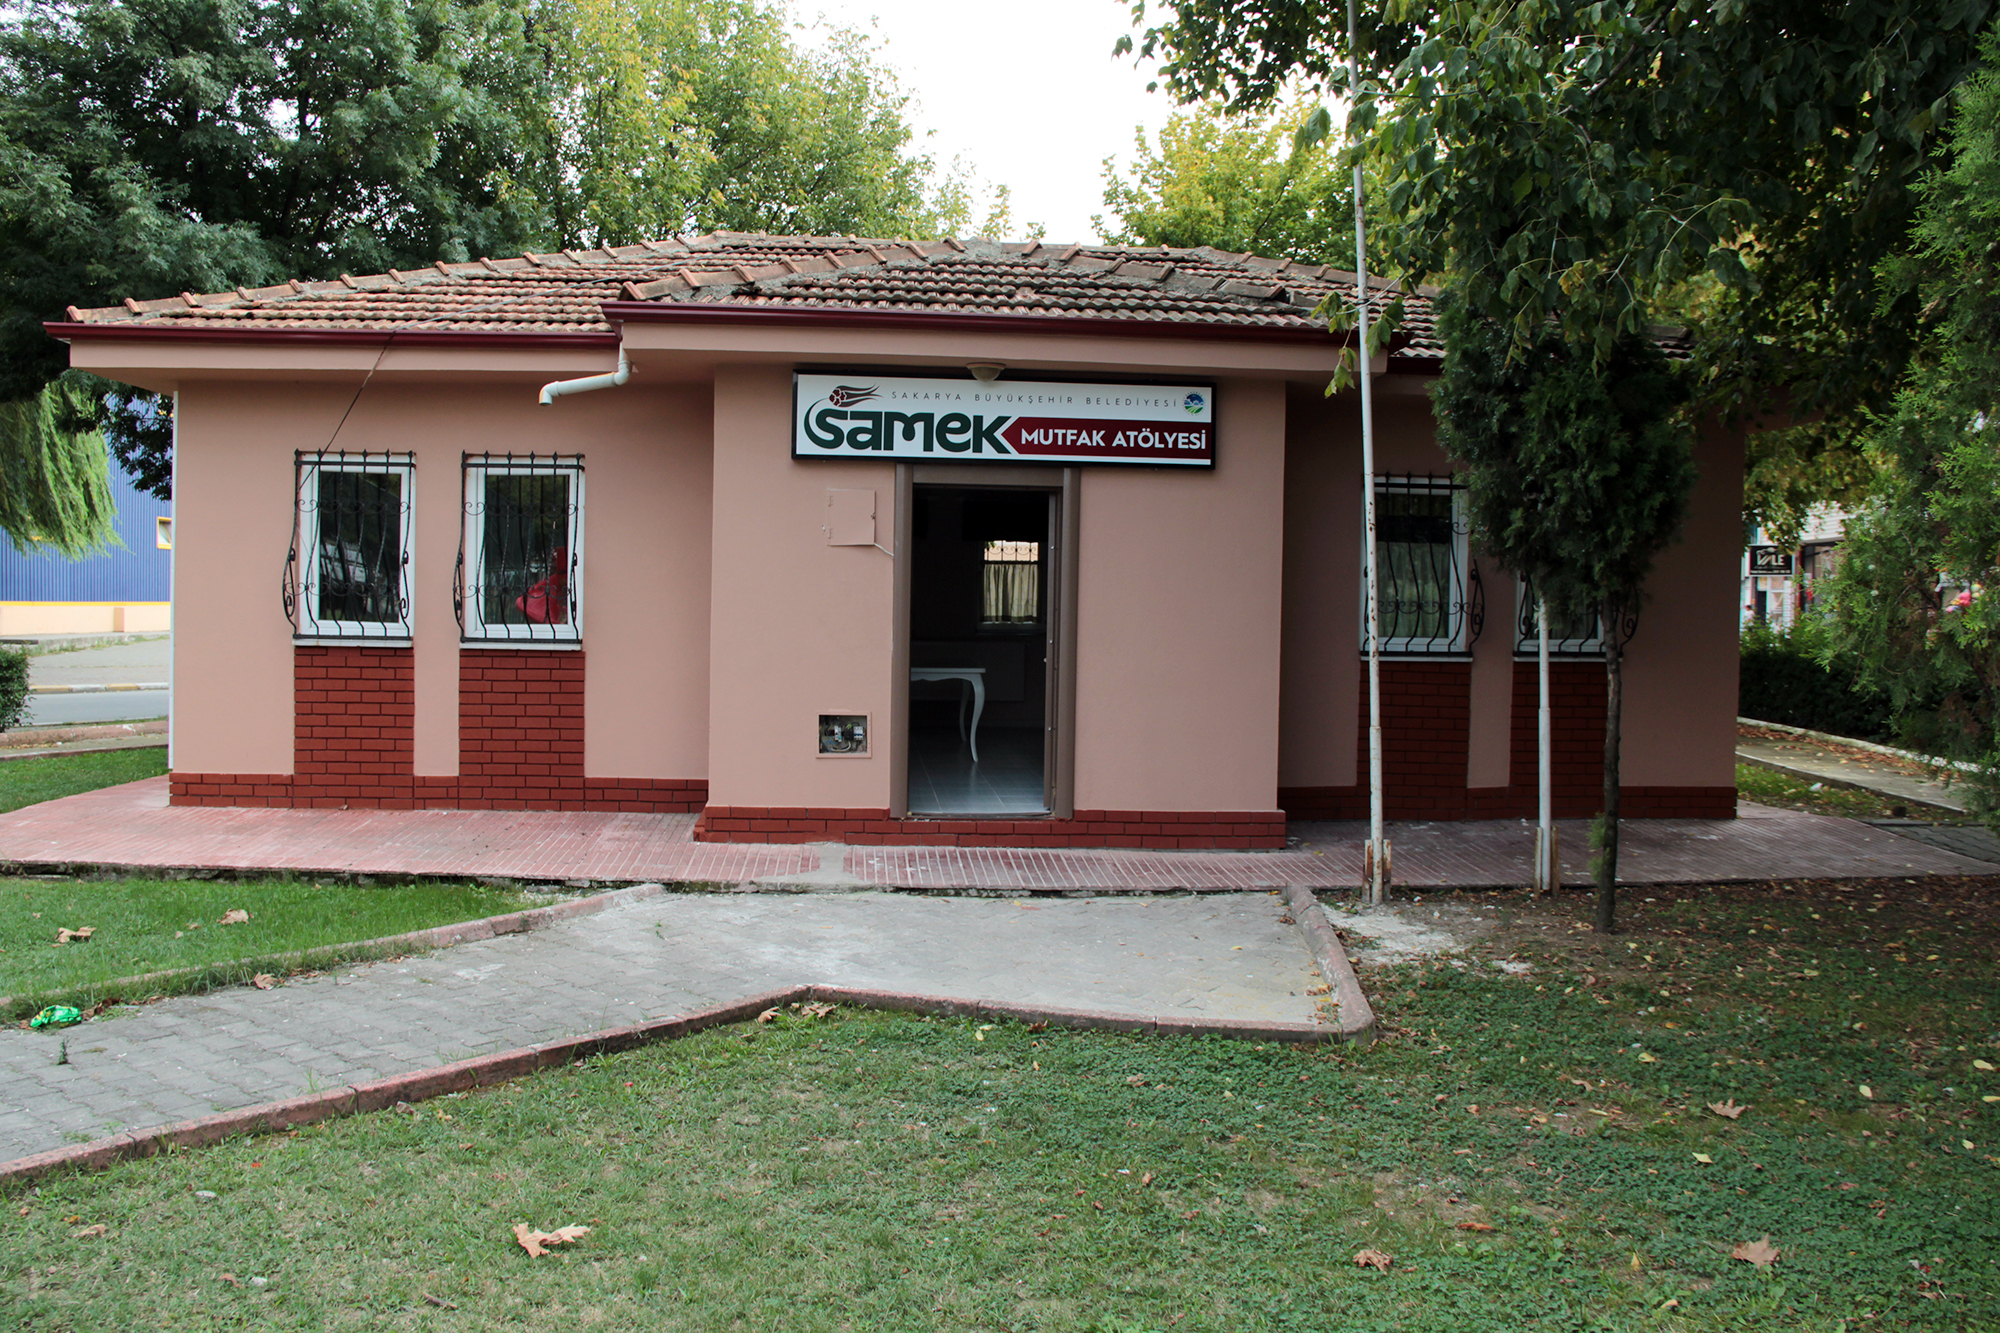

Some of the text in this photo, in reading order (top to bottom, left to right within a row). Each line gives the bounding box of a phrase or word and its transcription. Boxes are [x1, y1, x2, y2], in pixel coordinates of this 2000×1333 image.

[891, 391, 962, 401] SAKARYA
[974, 393, 1073, 405] BÜYÜKŞEHİR
[1085, 396, 1176, 407] BELEDİYESİ
[1021, 428, 1206, 449] MUTFAK ATÖLYESİ
